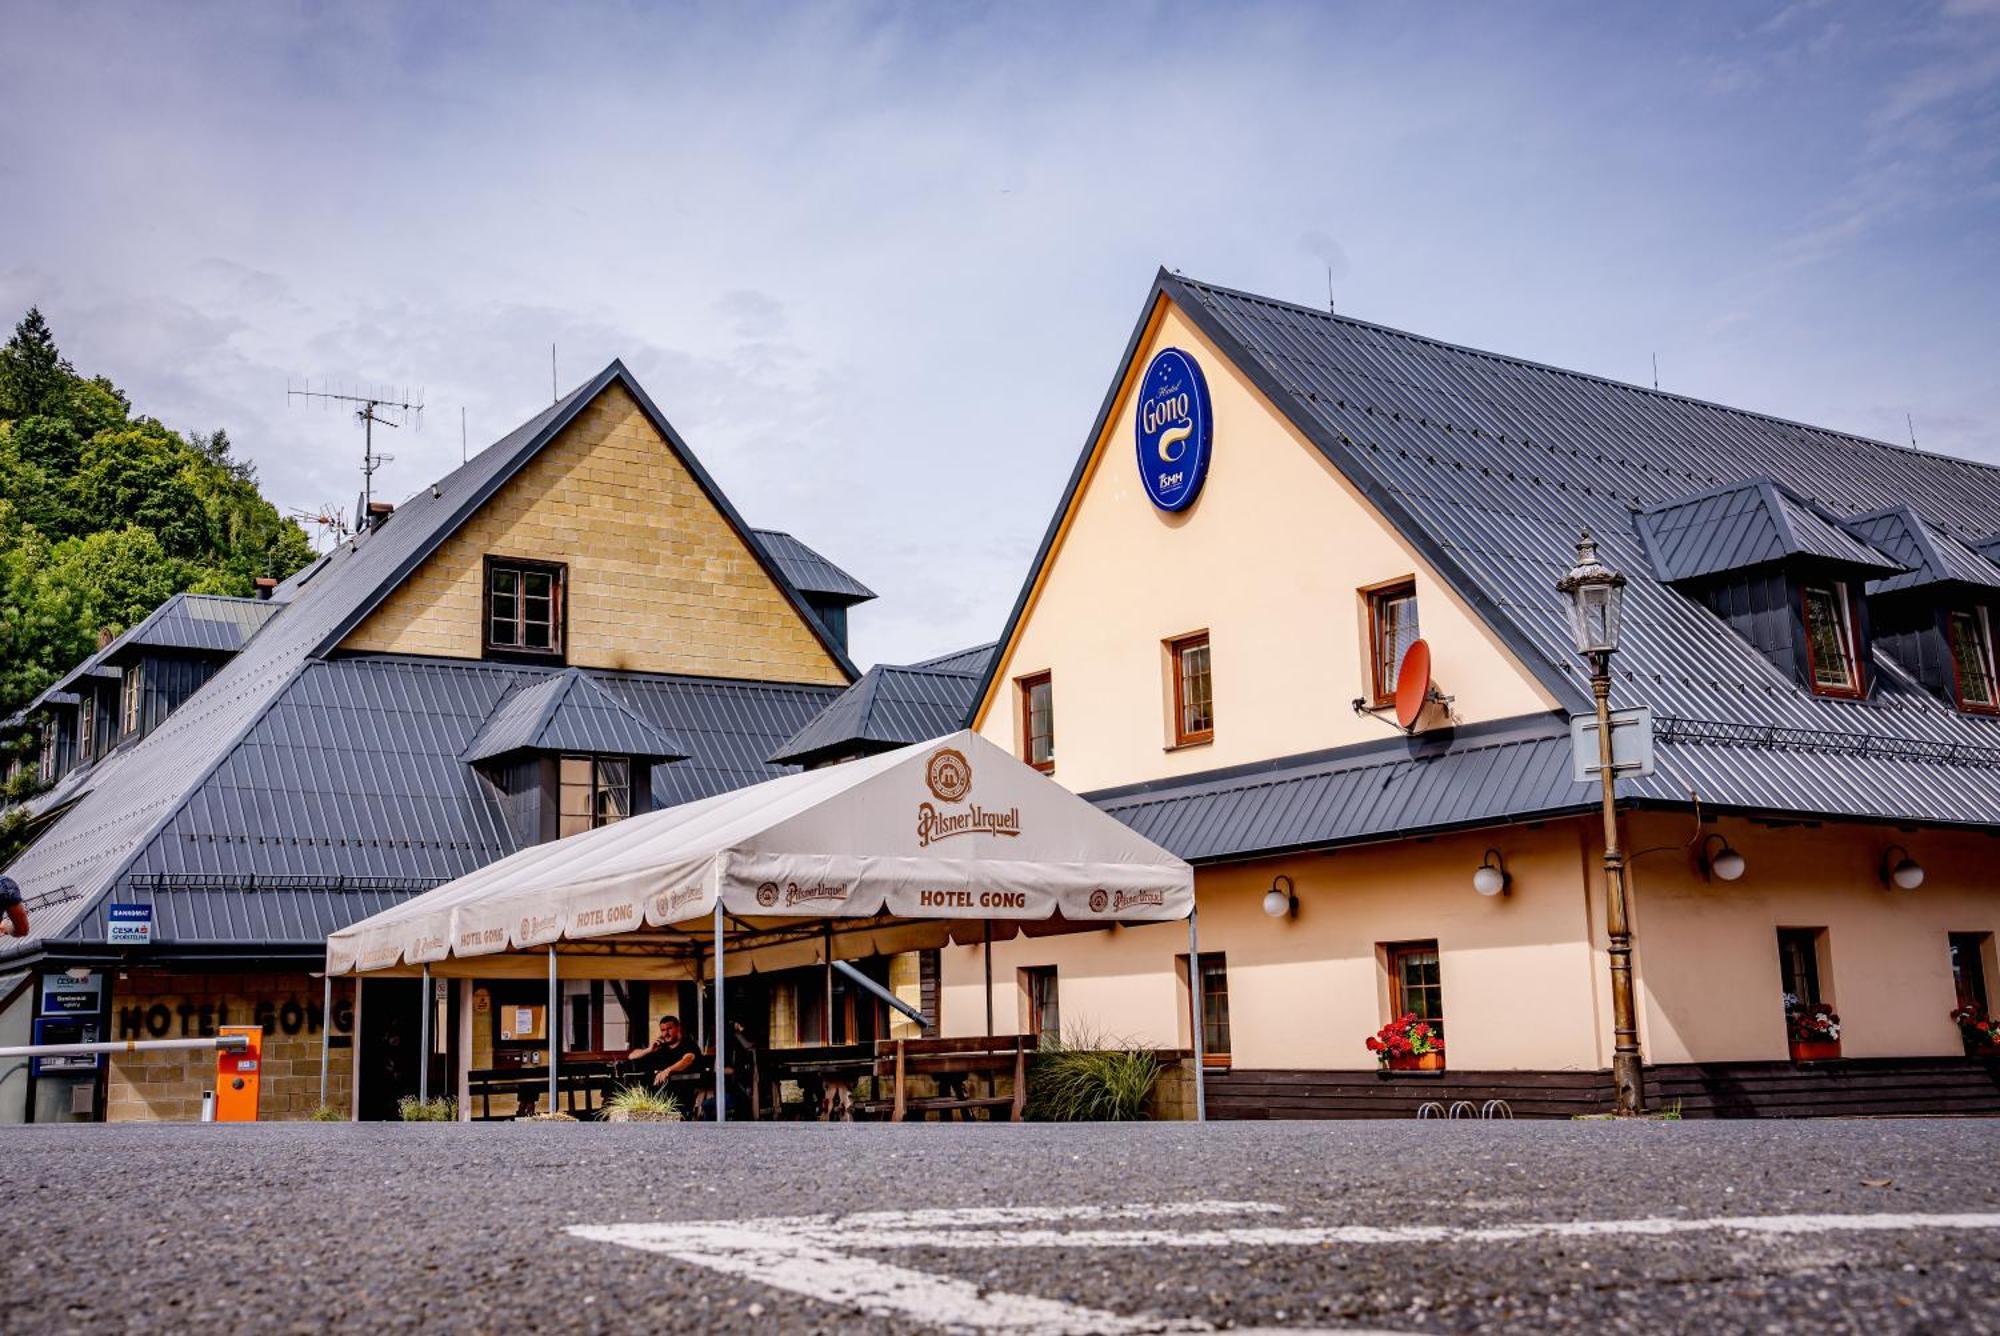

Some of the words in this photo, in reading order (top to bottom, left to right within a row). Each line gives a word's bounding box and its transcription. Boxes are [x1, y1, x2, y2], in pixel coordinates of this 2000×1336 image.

[1143, 392, 1191, 445] Gong
[917, 802, 971, 848] Pilsner
[969, 803, 1020, 838] Urquell
[920, 890, 974, 907] HOTEL
[979, 891, 1026, 908] GONG
[576, 909, 605, 928] HOTEL
[607, 903, 633, 922] GONG
[460, 931, 482, 947] HOTEL
[484, 928, 504, 944] GONG
[254, 1001, 353, 1036] GONG
